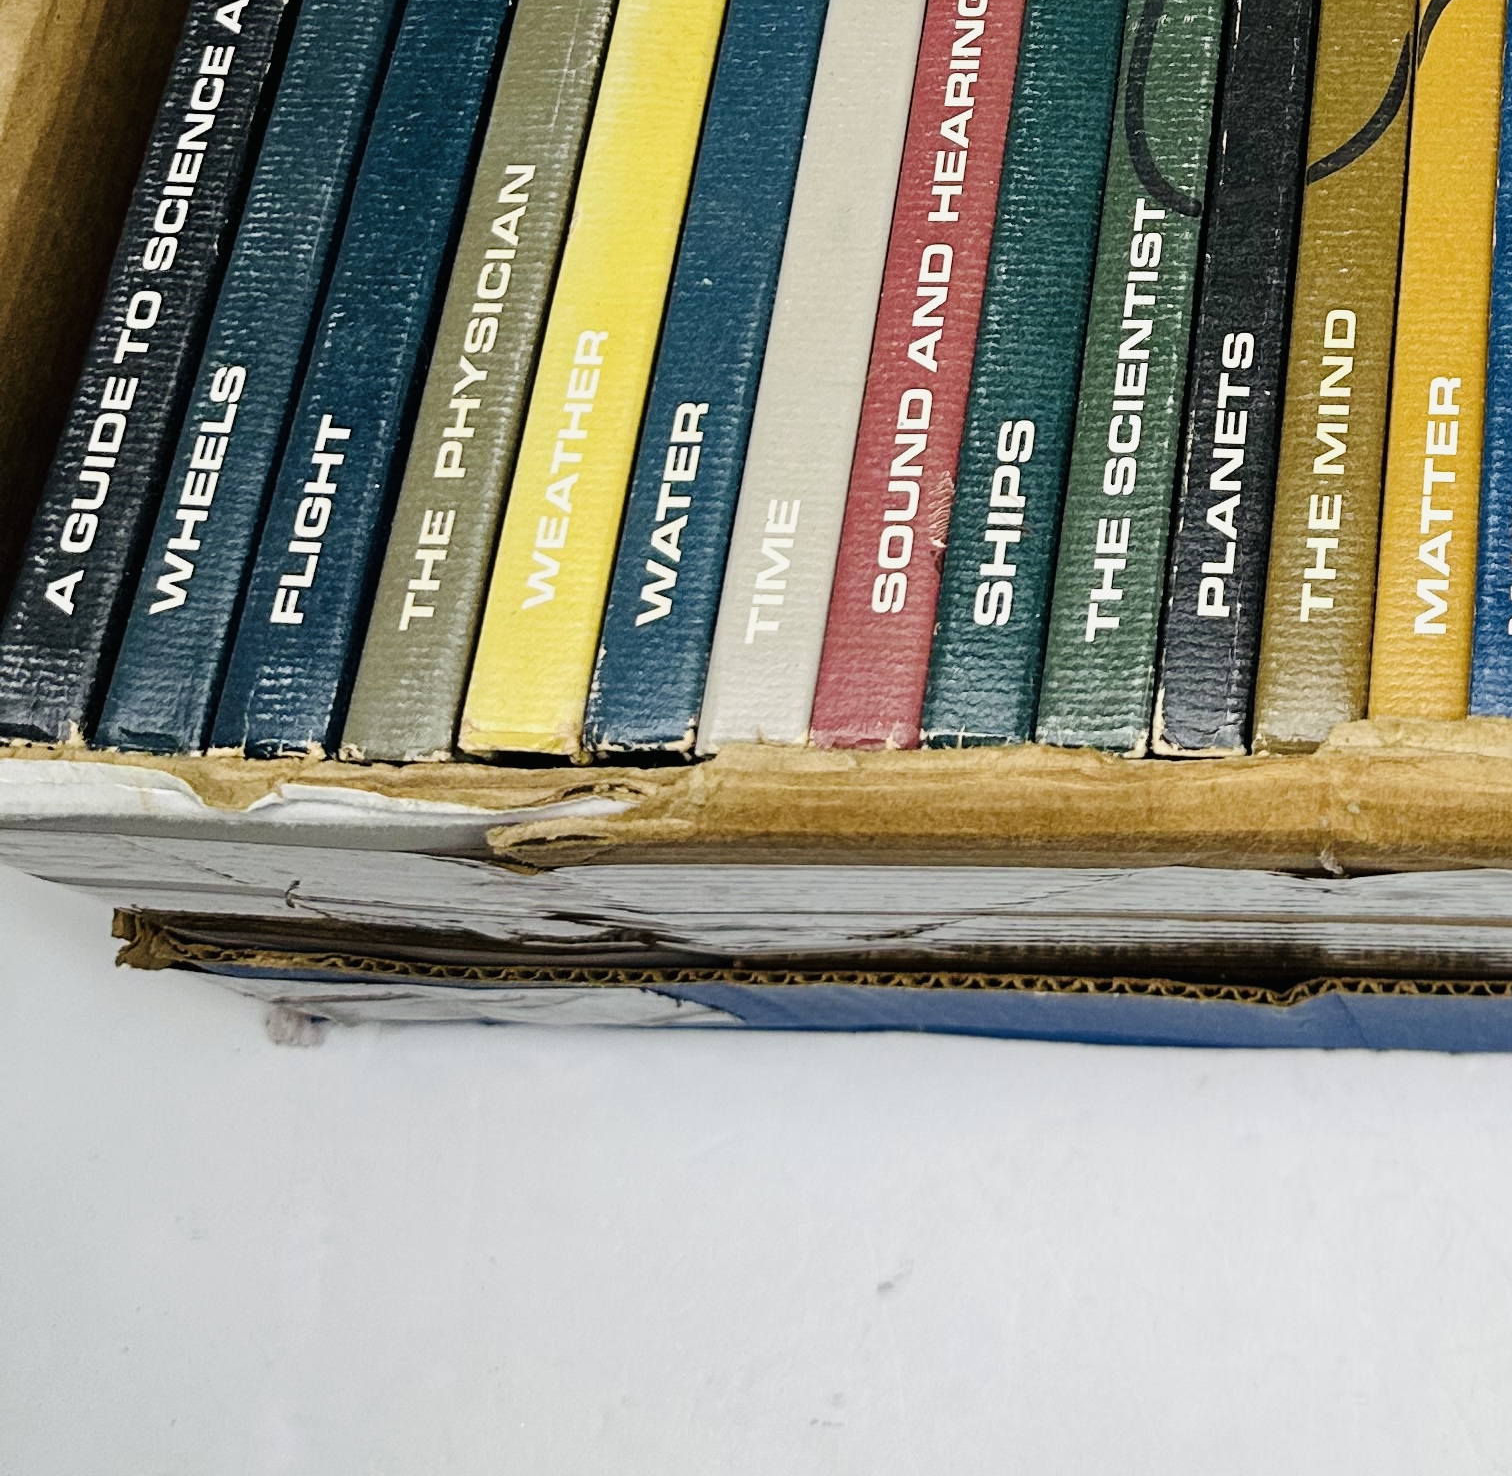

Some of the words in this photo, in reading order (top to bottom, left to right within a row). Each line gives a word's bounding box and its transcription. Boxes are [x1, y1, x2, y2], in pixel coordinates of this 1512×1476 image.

[143, 44, 235, 271] SCIENCE
[116, 290, 162, 376] TO
[400, 510, 455, 630] THE
[437, 163, 536, 479] PHYSICIAN
[872, 389, 932, 614] SOUND
[908, 244, 952, 372] AND
[1104, 198, 1166, 495] SCIENTIST
[1314, 308, 1357, 474] MIND
[61, 380, 137, 554] GUIDE
[149, 366, 246, 615] WHEELS
[271, 415, 352, 625] FLIGHT
[522, 330, 608, 610] WEATHER
[635, 402, 709, 627] WATER
[745, 500, 800, 644] TIME
[974, 420, 1035, 626] SHIPS
[1199, 332, 1255, 617] PLANETS
[1301, 493, 1342, 622] THE
[1414, 376, 1461, 634] MATTER
[44, 569, 84, 615] A
[1086, 517, 1130, 643] THE
